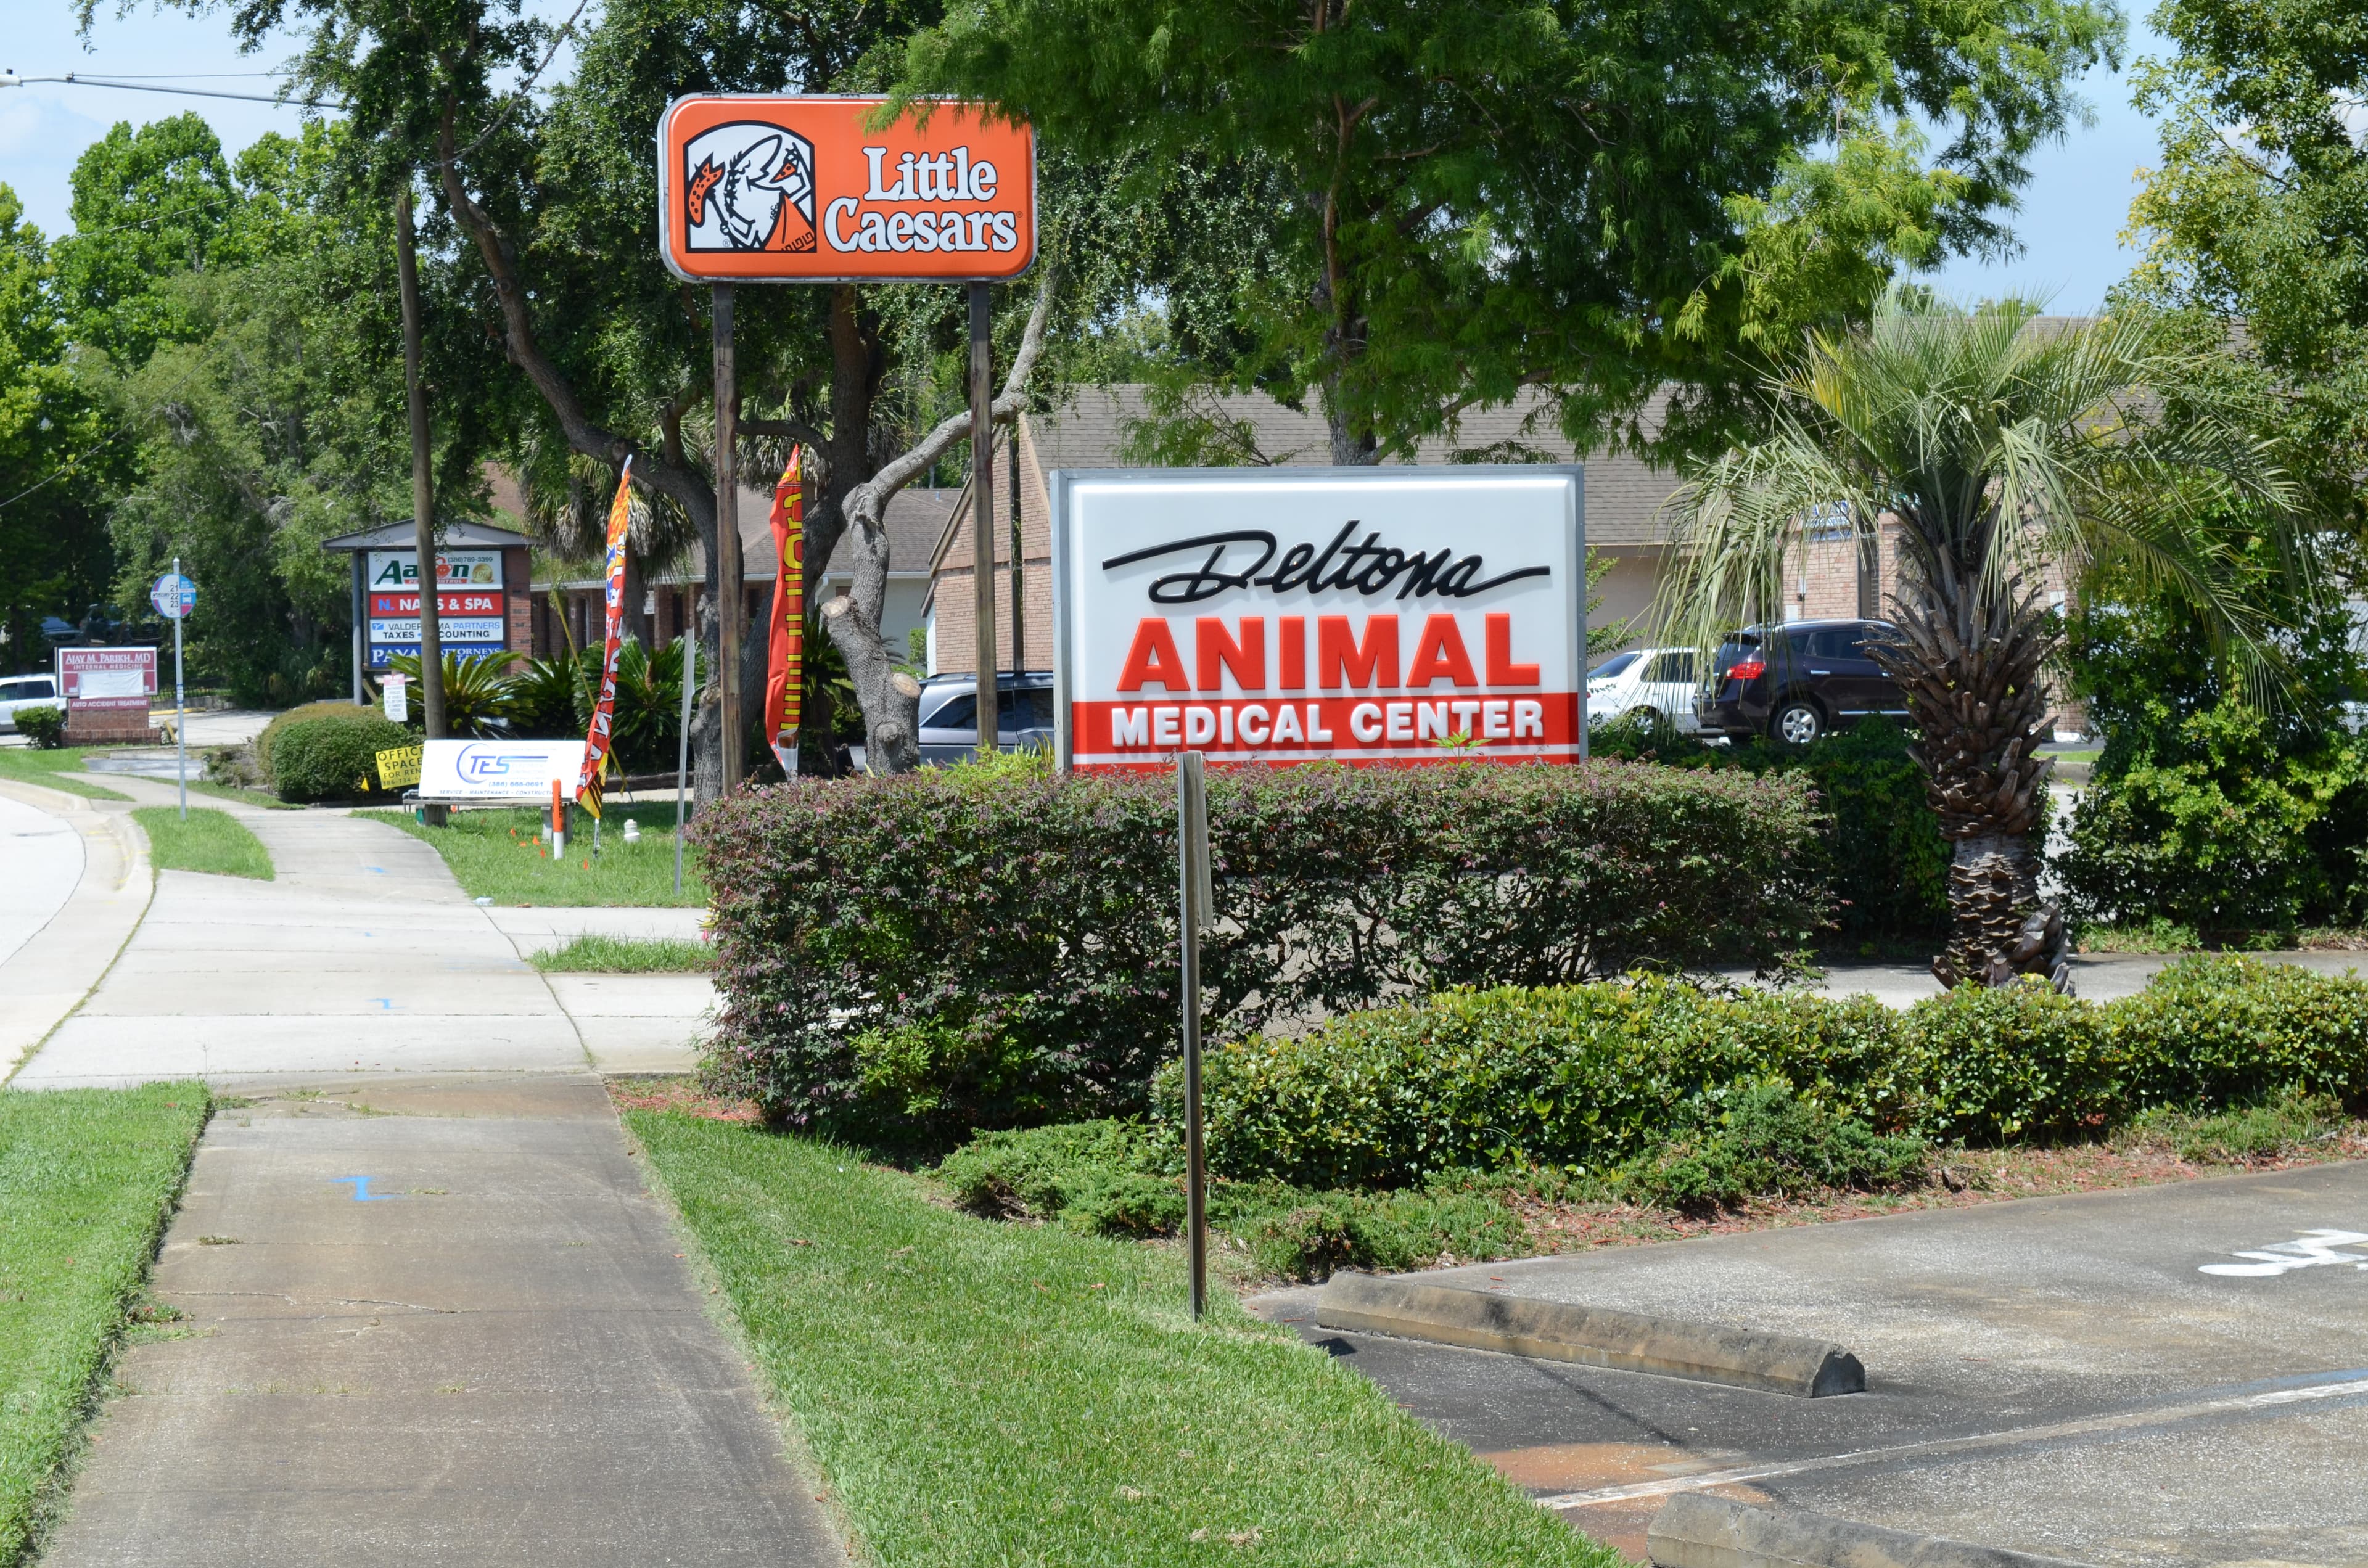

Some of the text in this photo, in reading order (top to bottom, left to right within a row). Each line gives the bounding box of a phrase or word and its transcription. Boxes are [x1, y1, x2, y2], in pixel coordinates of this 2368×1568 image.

[862, 146, 997, 202] Little
[824, 197, 1019, 253] Caesars
[1101, 520, 1550, 604] Deltona
[400, 599, 444, 610] NAS
[449, 599, 460, 610] &
[465, 598, 493, 610] SPA
[134, 653, 150, 663] MD
[1117, 612, 1540, 691] ANIMAL
[1111, 700, 1544, 747] MEDICAL CENTER
[377, 745, 424, 761] OFFICE
[384, 758, 422, 771] SPACE
[384, 768, 421, 779] FOR REN
